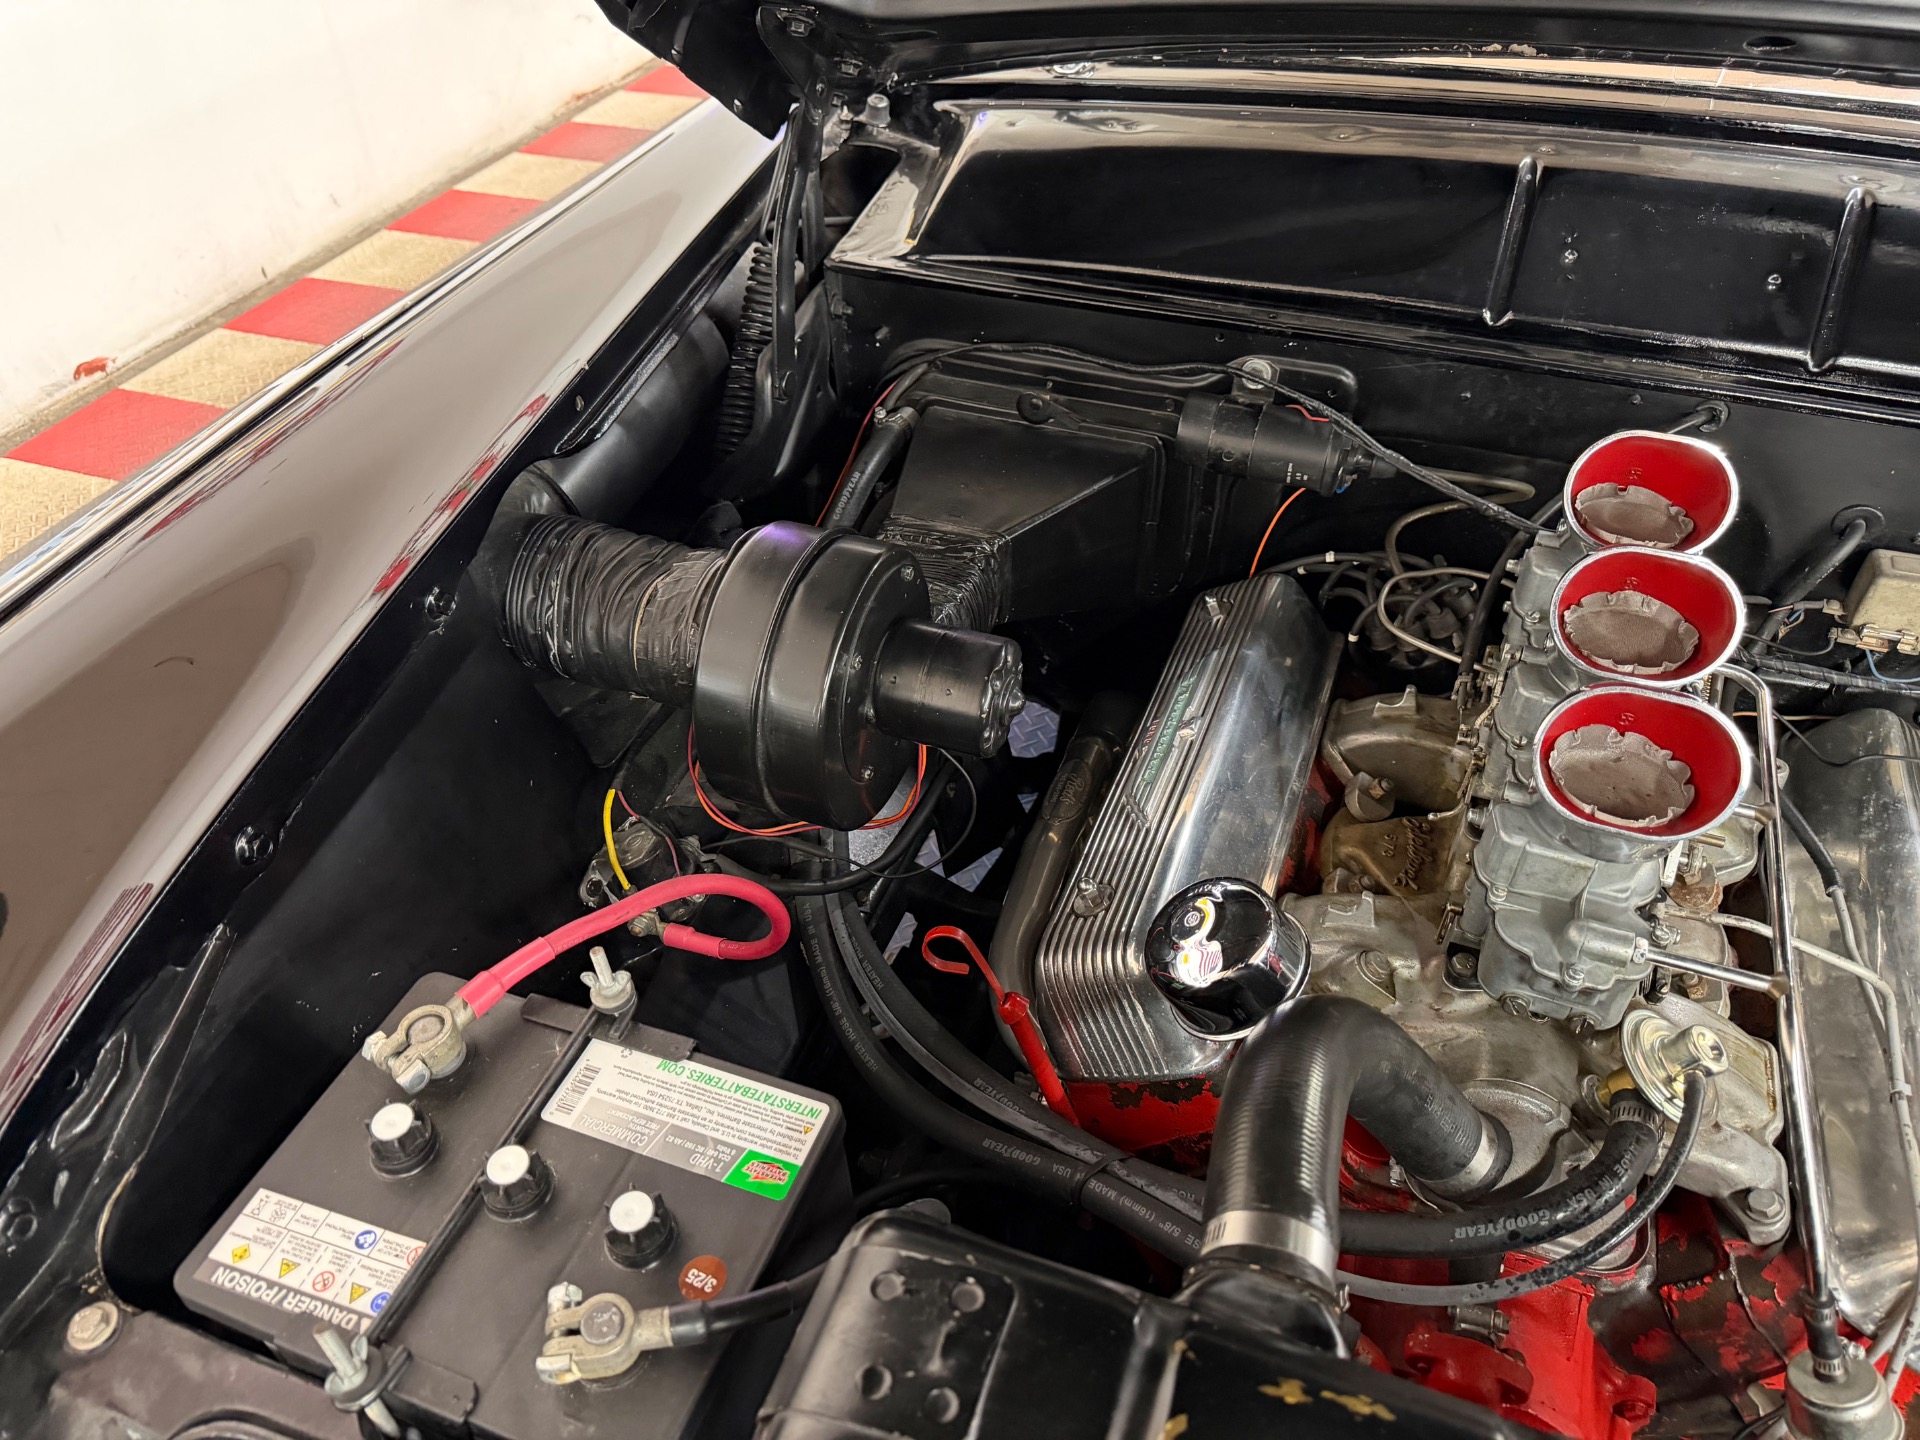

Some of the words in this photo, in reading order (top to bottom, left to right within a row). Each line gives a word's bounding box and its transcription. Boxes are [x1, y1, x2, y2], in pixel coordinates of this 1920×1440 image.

[833, 471, 861, 520] GOODYEAR
[803, 902, 812, 922] USA
[807, 924, 816, 936] IN
[810, 939, 823, 964] MADE
[818, 968, 835, 997] (16mm)
[862, 960, 885, 990] HEATER
[839, 1017, 856, 1041] HOSE
[854, 1041, 878, 1073] HEATER
[644, 1089, 659, 1097] USA
[655, 1059, 822, 1119] INTERSTATEBATTERIES.COM
[674, 1098, 684, 1106] TX
[606, 1107, 647, 1125] REPLACEMENT
[645, 1120, 660, 1129] FREE
[740, 1119, 769, 1133] Interstate
[576, 1114, 649, 1147] COMMERCIAL
[775, 1130, 807, 1145] Distributed
[715, 1143, 732, 1153] Volts
[717, 1152, 731, 1161] CCA
[982, 1137, 1041, 1167] GOODYEAR
[689, 1152, 723, 1173] 1-VHD
[750, 1161, 787, 1177] BATTERIES
[1052, 1162, 1072, 1179] USA
[744, 1165, 785, 1183] INTERSTATE
[1597, 1174, 1613, 1191] IN
[1088, 1178, 1118, 1200] MADE
[1566, 1187, 1597, 1209] USA
[1119, 1195, 1156, 1223] (16mm)
[1158, 1221, 1182, 1239] 5/8"
[1454, 1209, 1550, 1239] GOODYEAR
[685, 1268, 717, 1293] 3/25
[282, 1291, 359, 1330] DANGER
